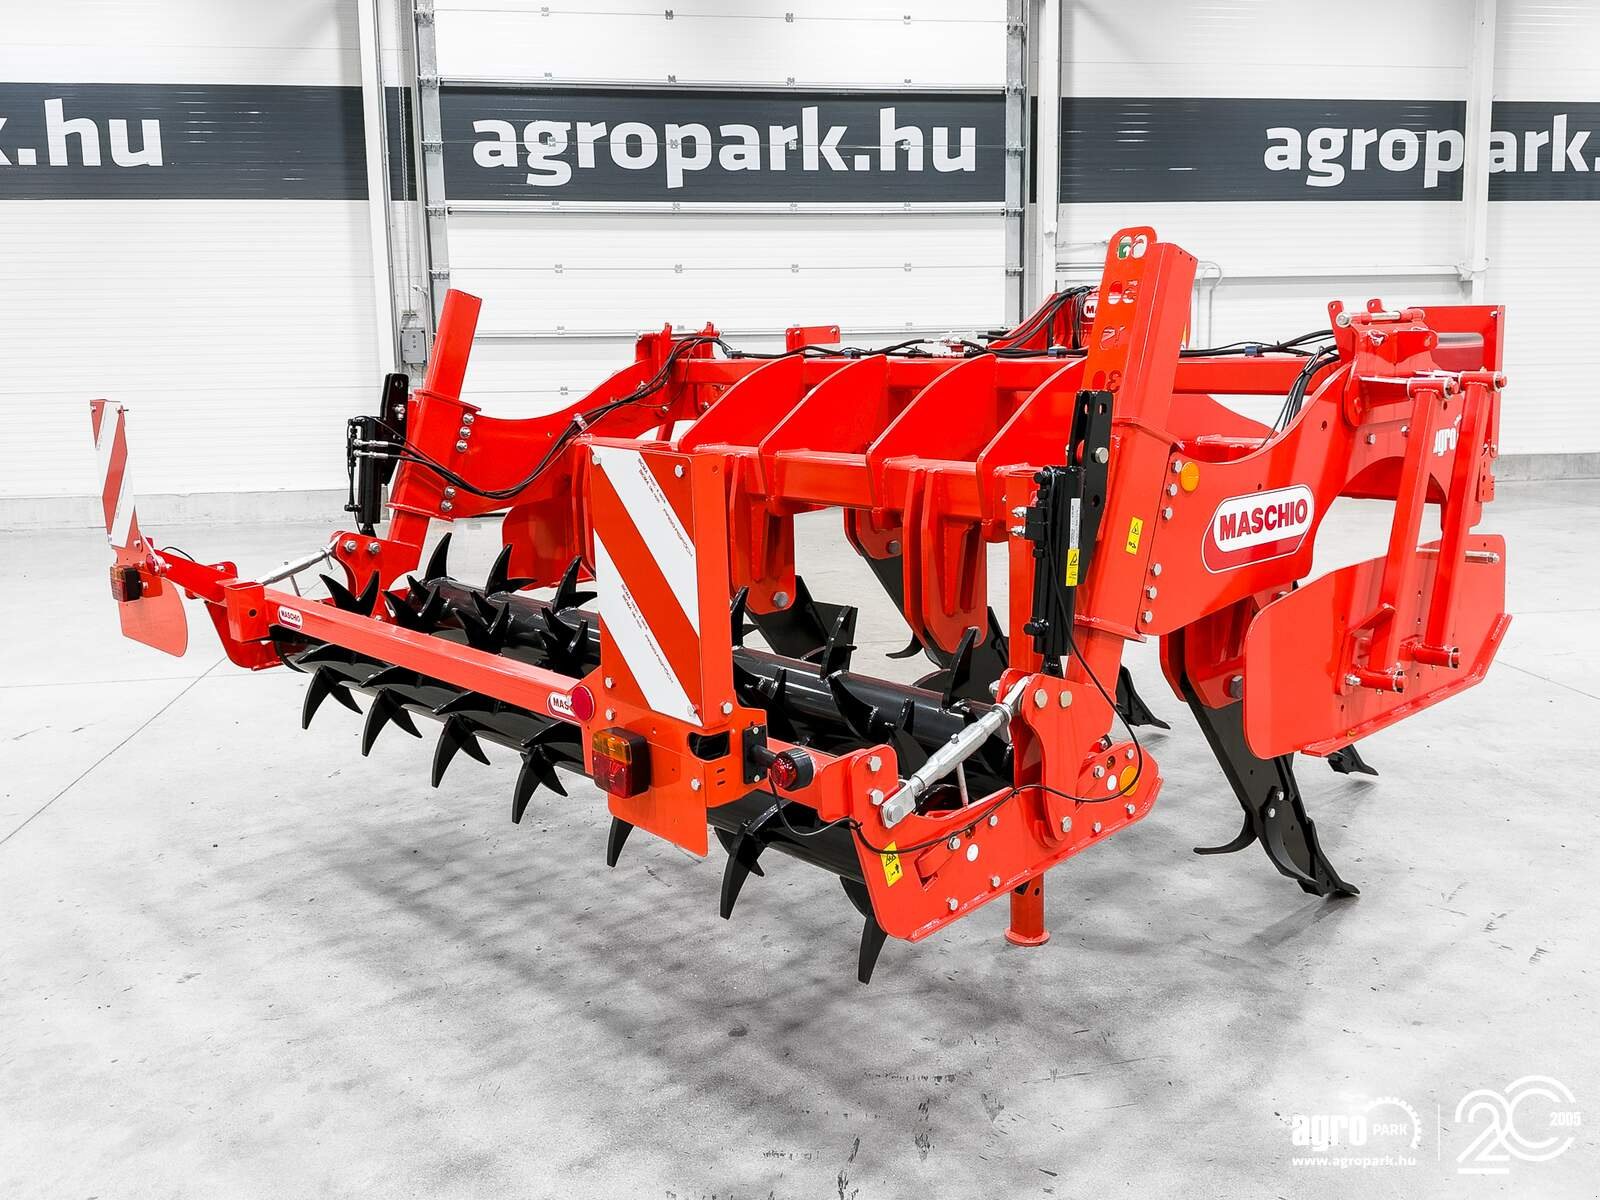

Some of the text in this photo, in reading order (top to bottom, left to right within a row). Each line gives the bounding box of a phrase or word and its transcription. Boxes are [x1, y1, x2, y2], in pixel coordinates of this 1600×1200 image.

[0, 98, 163, 167] .hu
[472, 106, 977, 189] agropark.hu
[1433, 428, 1457, 456] gro
[1220, 499, 1308, 541] MASCHIO
[553, 697, 570, 710] MAS
